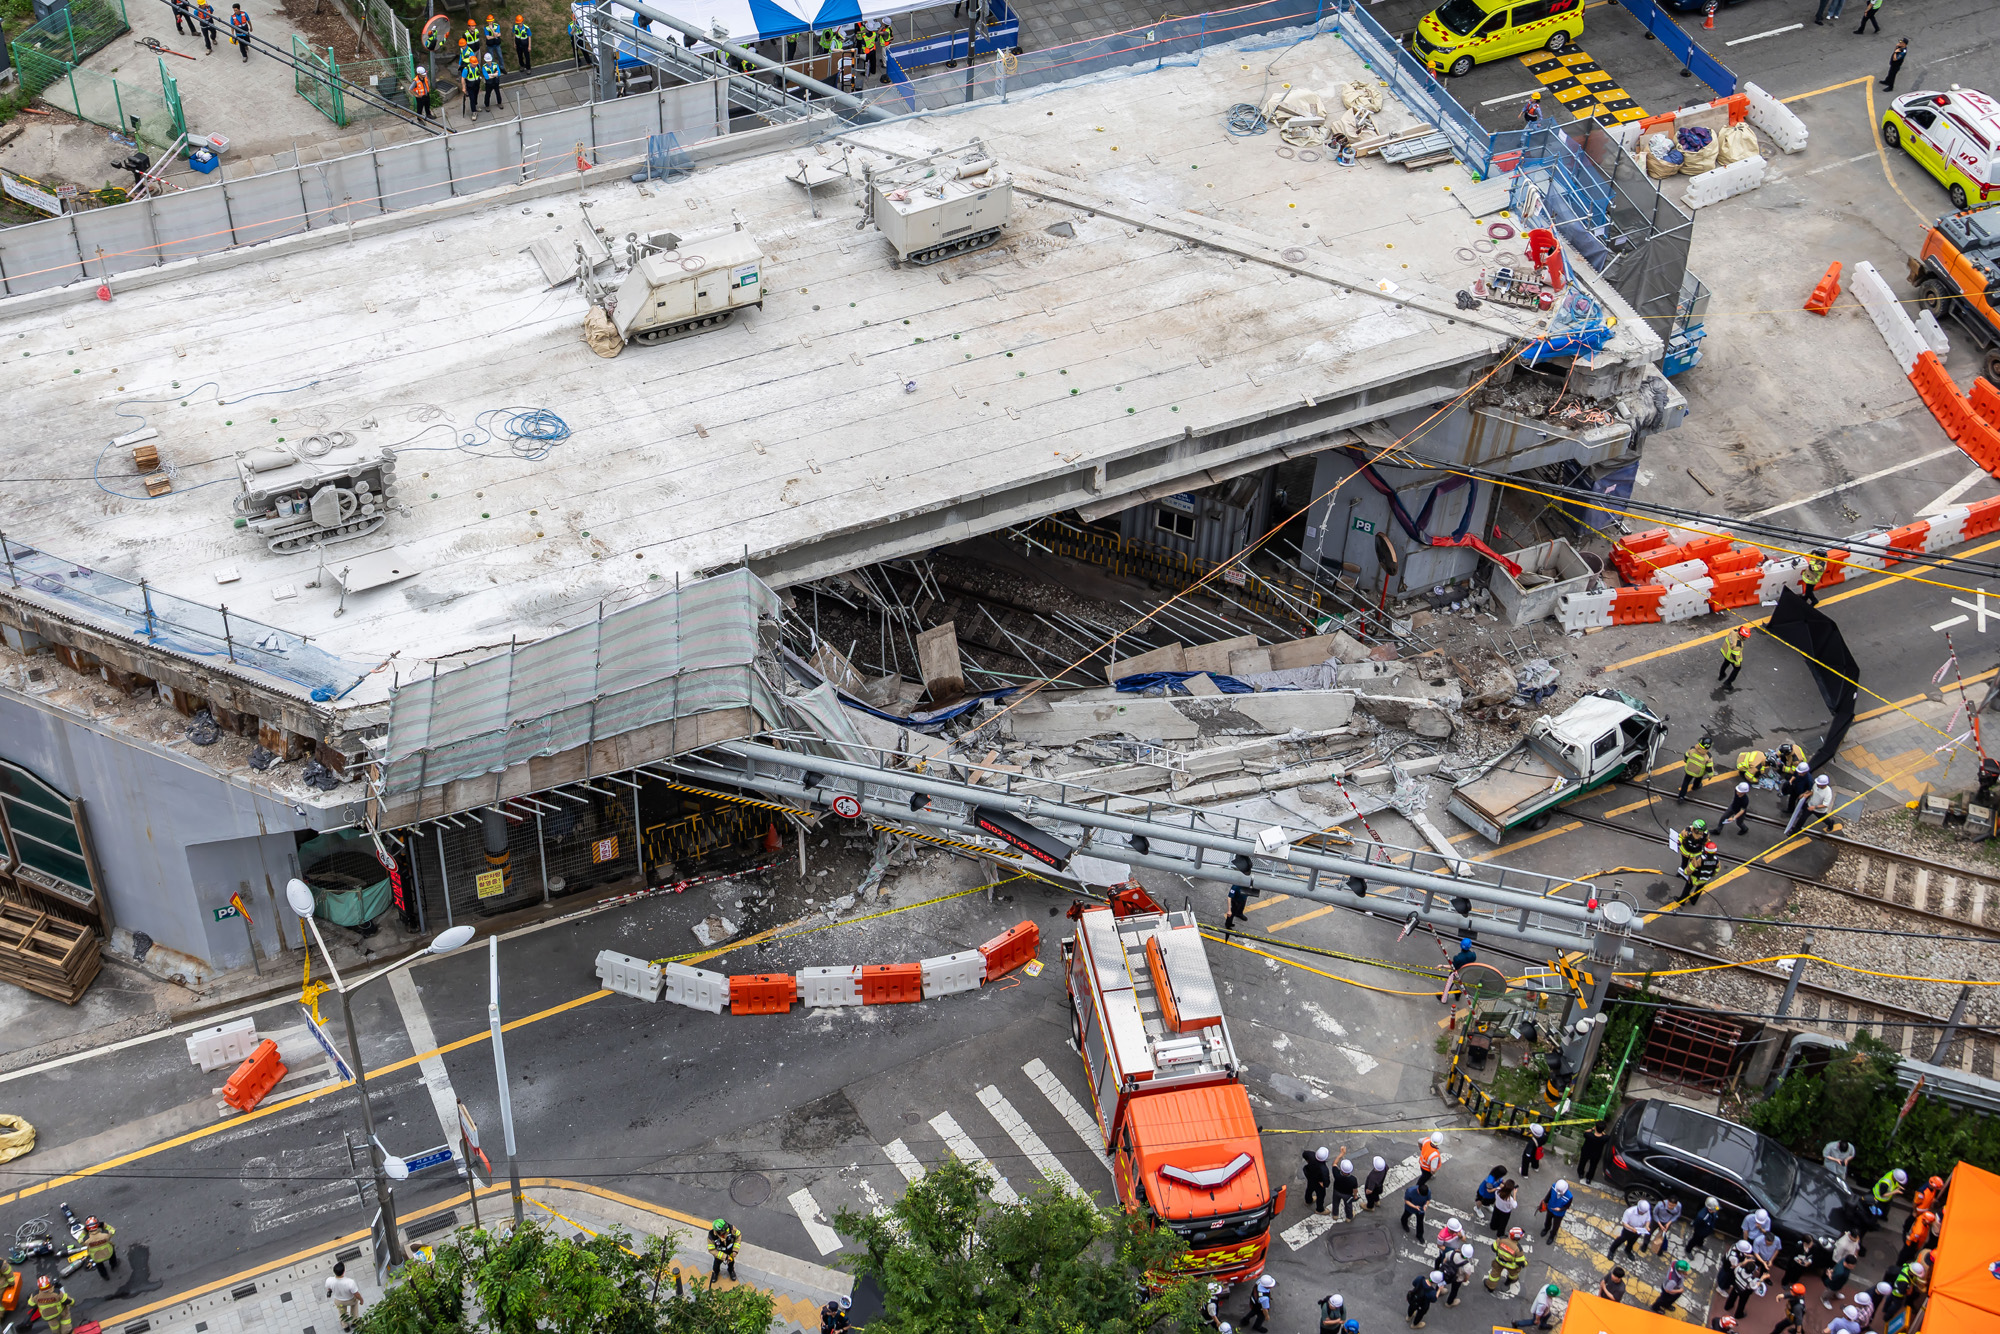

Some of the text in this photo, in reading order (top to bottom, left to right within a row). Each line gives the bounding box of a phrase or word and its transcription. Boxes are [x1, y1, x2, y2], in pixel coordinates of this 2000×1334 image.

[1549, 0, 1572, 13] 119
[1959, 152, 1978, 165] 119
[1356, 520, 1371, 532] P8
[218, 906, 236, 919] P9
